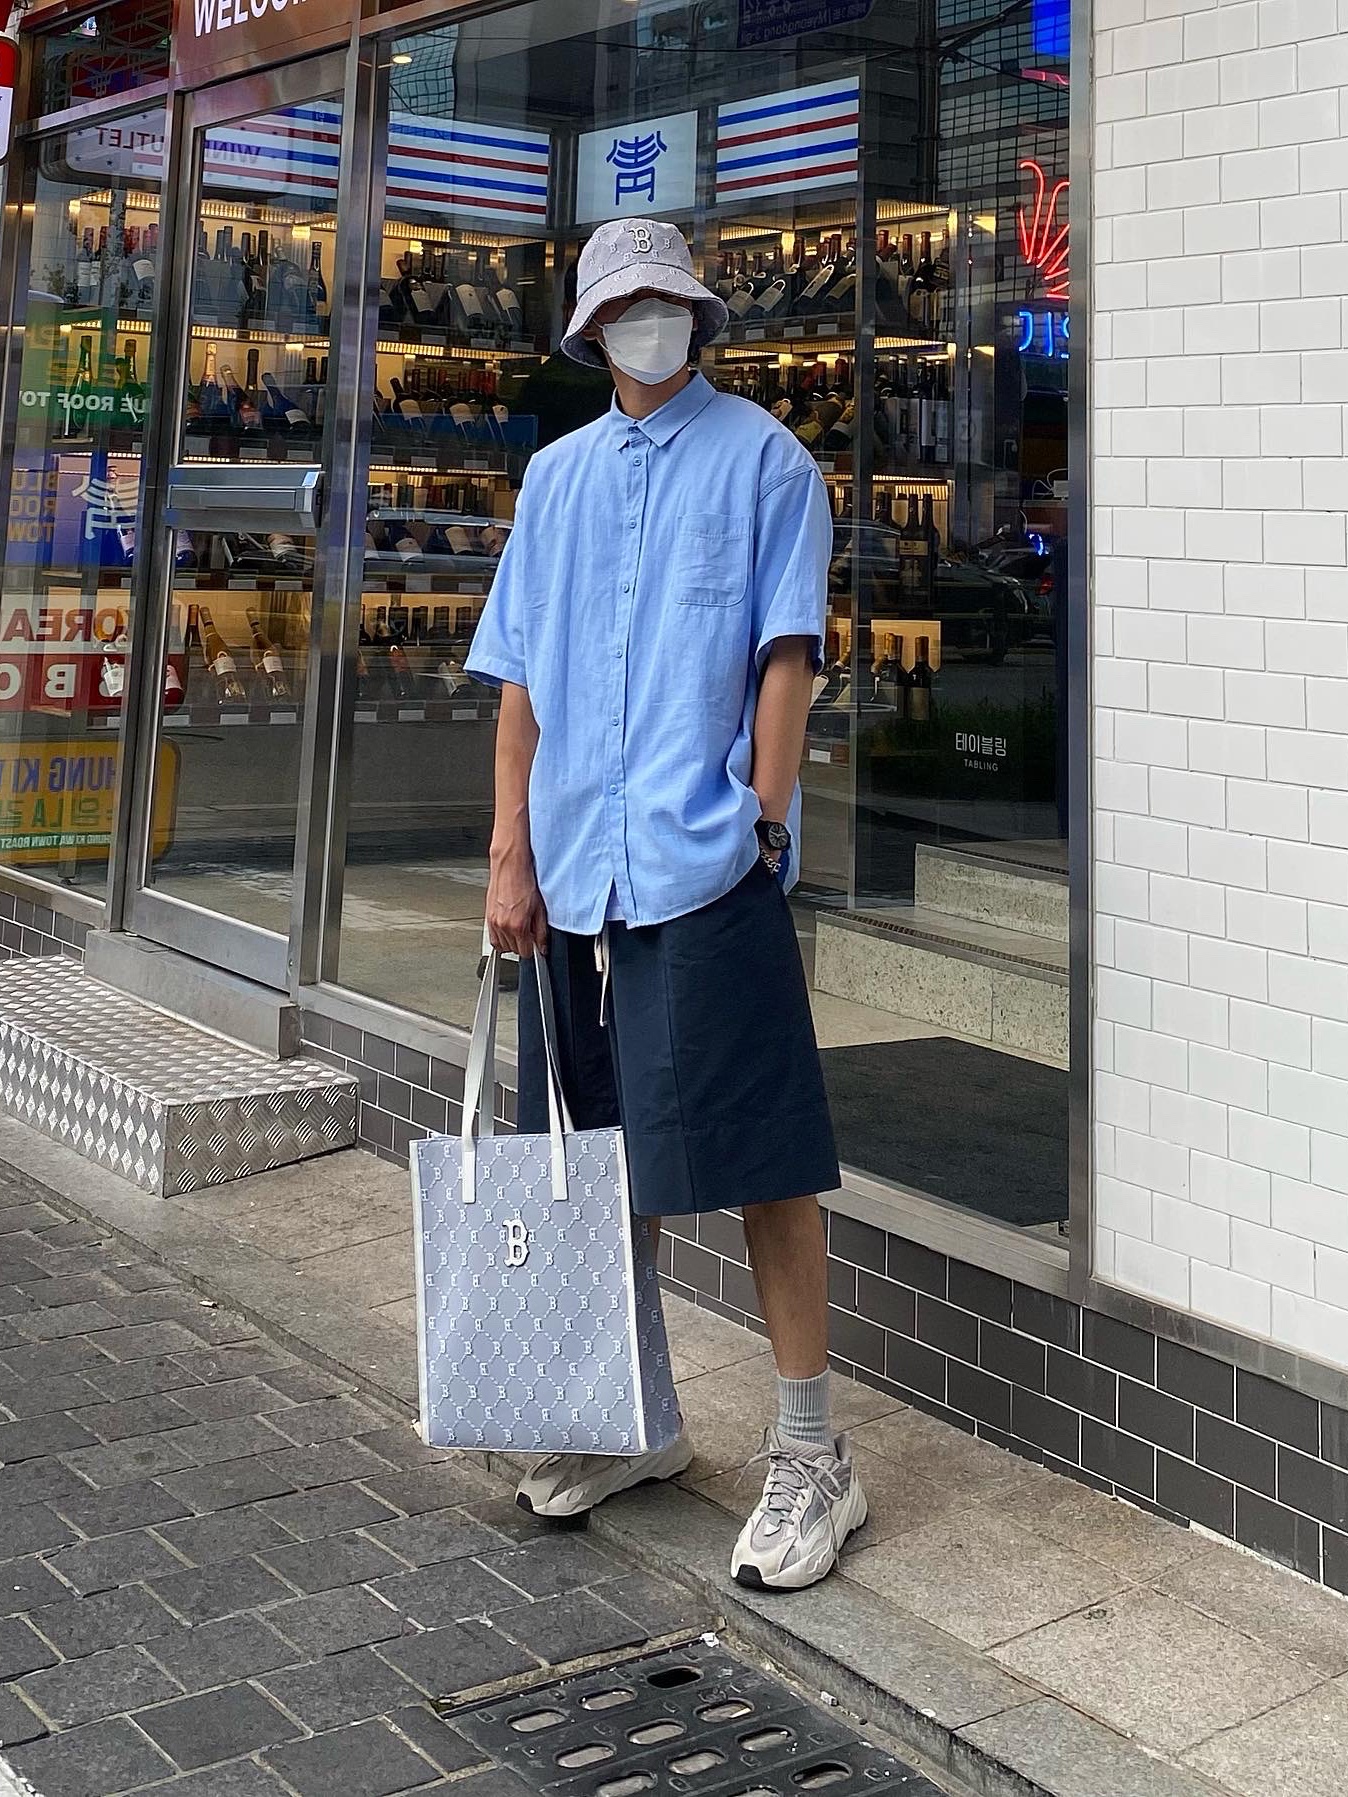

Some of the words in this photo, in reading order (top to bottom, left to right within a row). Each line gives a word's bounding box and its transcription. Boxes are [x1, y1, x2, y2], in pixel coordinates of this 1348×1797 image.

[629, 226, 653, 254] B
[955, 731, 1007, 758] 테이블링
[964, 758, 999, 773] TABLING
[502, 1218, 530, 1268] B
